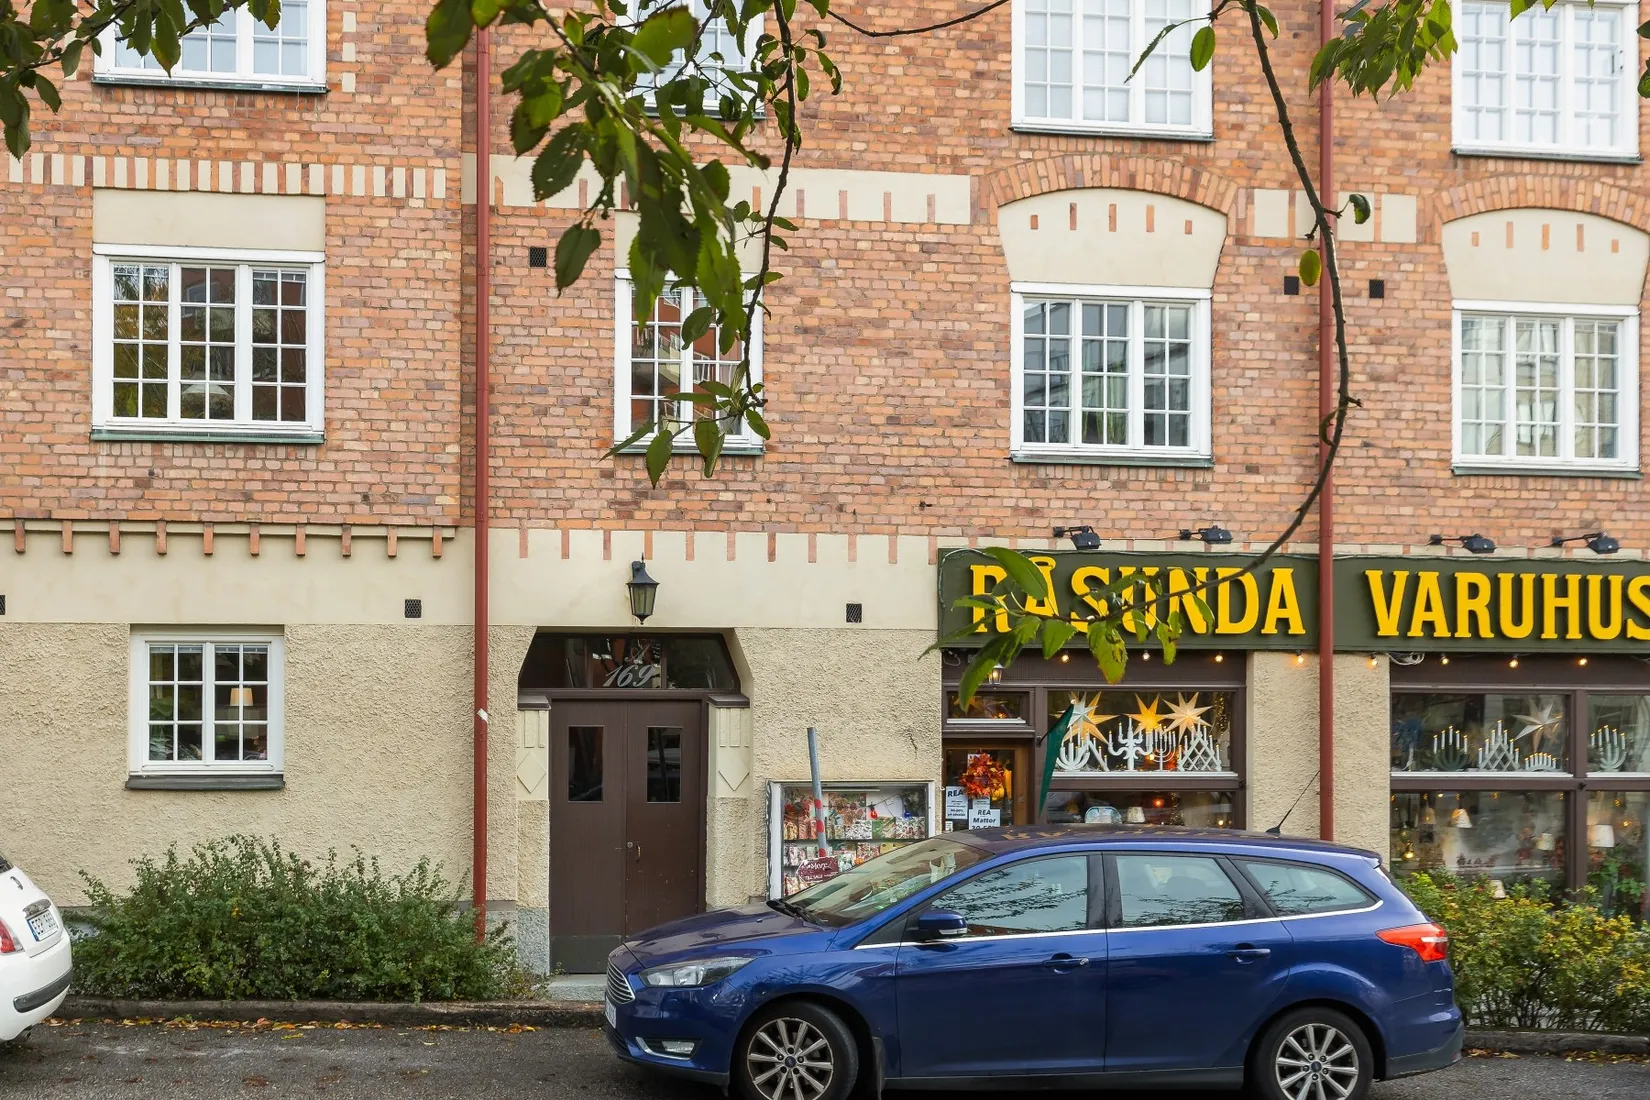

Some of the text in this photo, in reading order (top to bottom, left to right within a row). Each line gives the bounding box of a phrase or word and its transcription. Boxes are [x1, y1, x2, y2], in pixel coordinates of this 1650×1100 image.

[1365, 569, 1650, 640] VARUHUS
[603, 664, 652, 687] 169
[947, 789, 964, 797] REA
